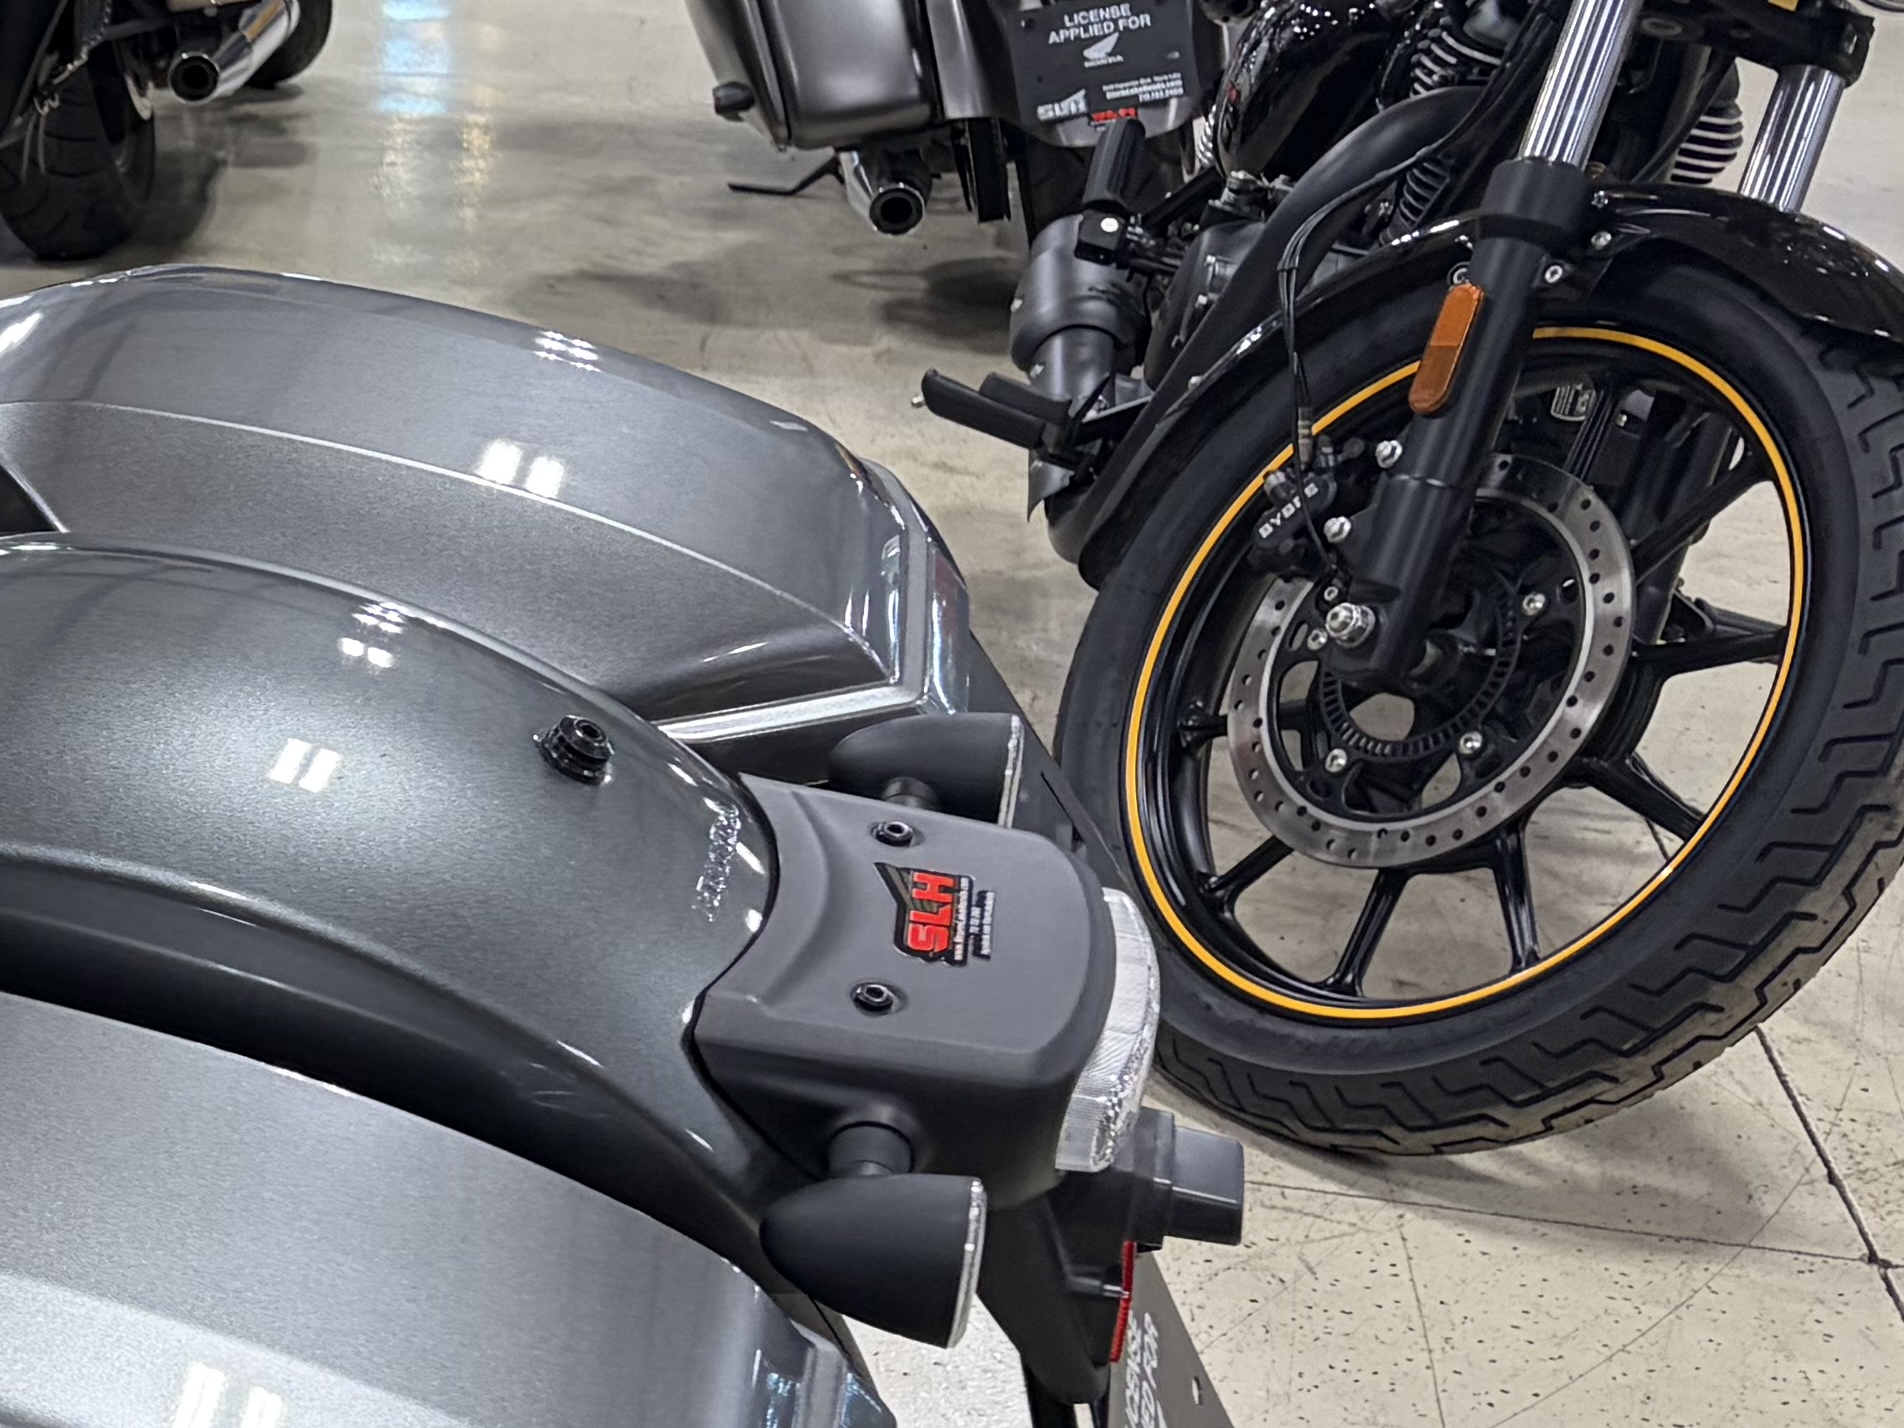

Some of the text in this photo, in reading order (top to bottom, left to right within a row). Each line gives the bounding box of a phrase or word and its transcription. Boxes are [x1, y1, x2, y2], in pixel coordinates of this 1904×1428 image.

[1048, 13, 1151, 44] APPLIED FOR
[1063, 3, 1131, 27] LICENSE
[907, 871, 955, 953] SLH
[1143, 1311, 1160, 1390] FOR
